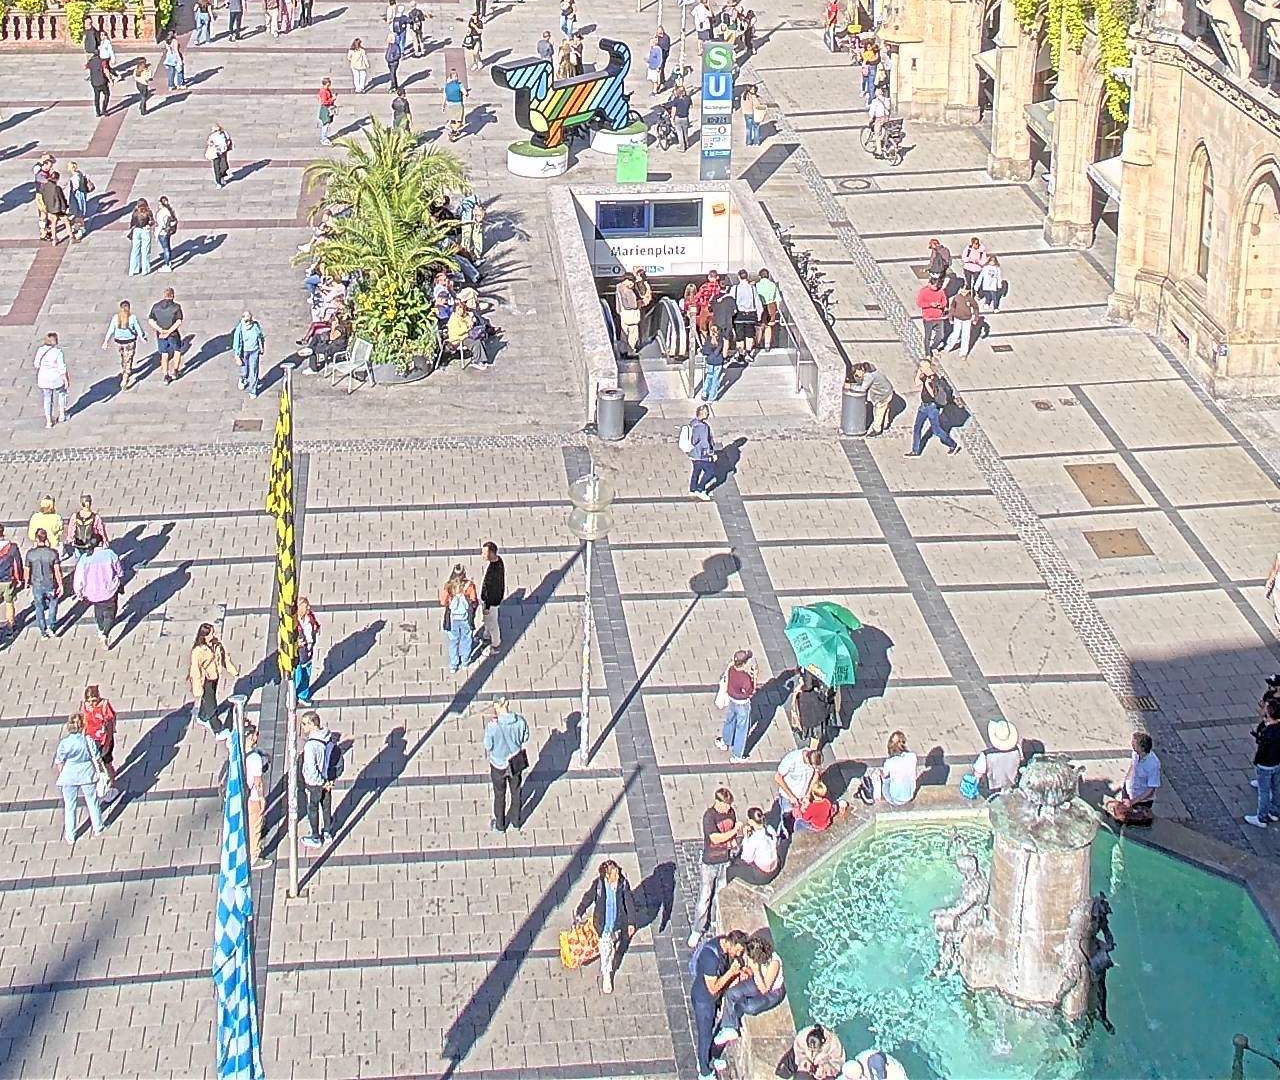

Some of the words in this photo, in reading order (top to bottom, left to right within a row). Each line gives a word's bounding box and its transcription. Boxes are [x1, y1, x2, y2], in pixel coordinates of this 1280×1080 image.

[708, 46, 728, 70] S
[708, 75, 727, 97] U
[610, 244, 686, 258] Marienplatz
